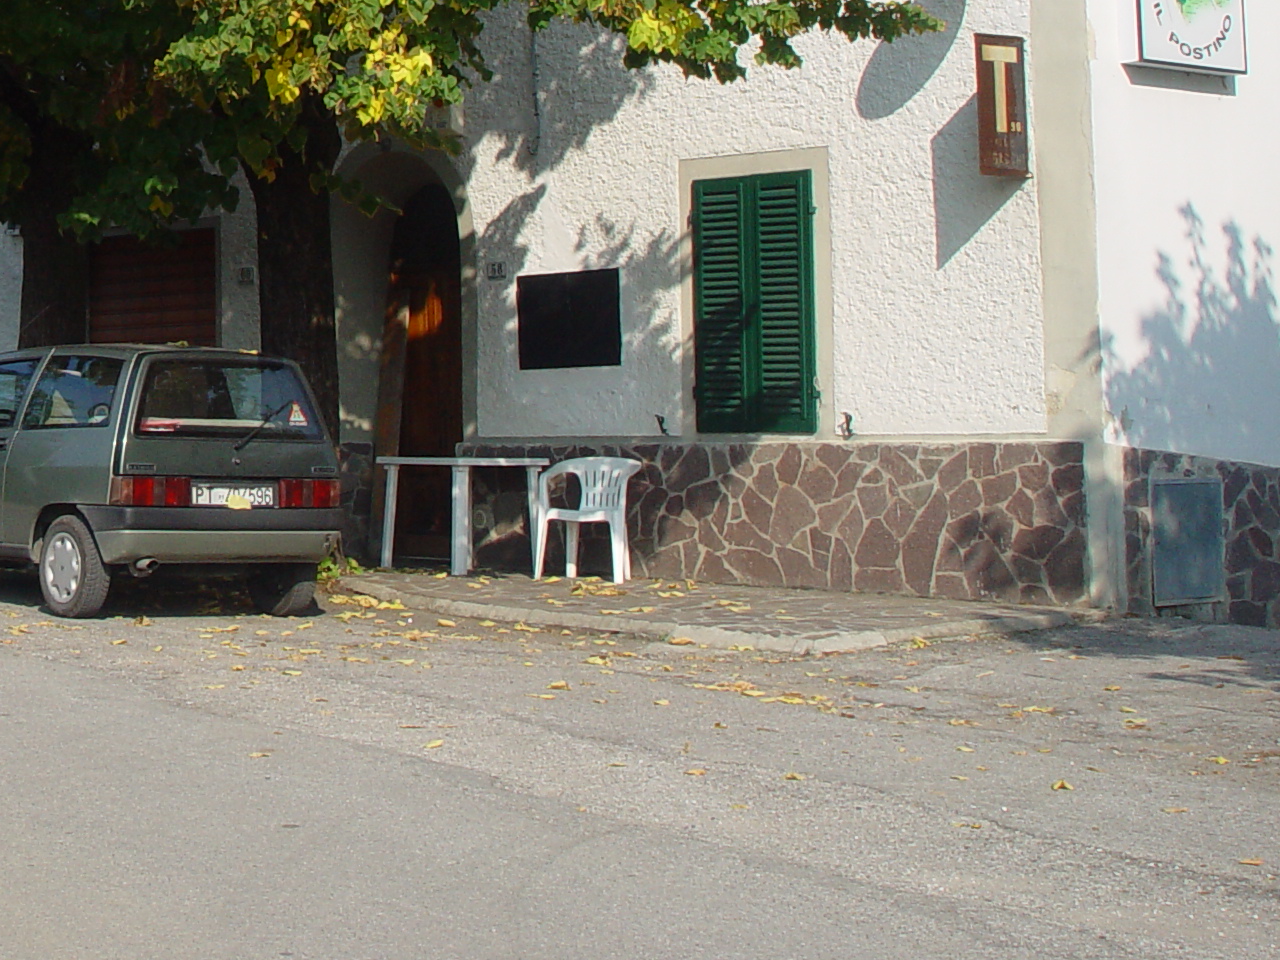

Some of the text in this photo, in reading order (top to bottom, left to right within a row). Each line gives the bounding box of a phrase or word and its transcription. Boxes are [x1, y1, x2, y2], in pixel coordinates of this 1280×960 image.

[1153, 2, 1232, 60] IL POSTINO
[981, 43, 1018, 133] T
